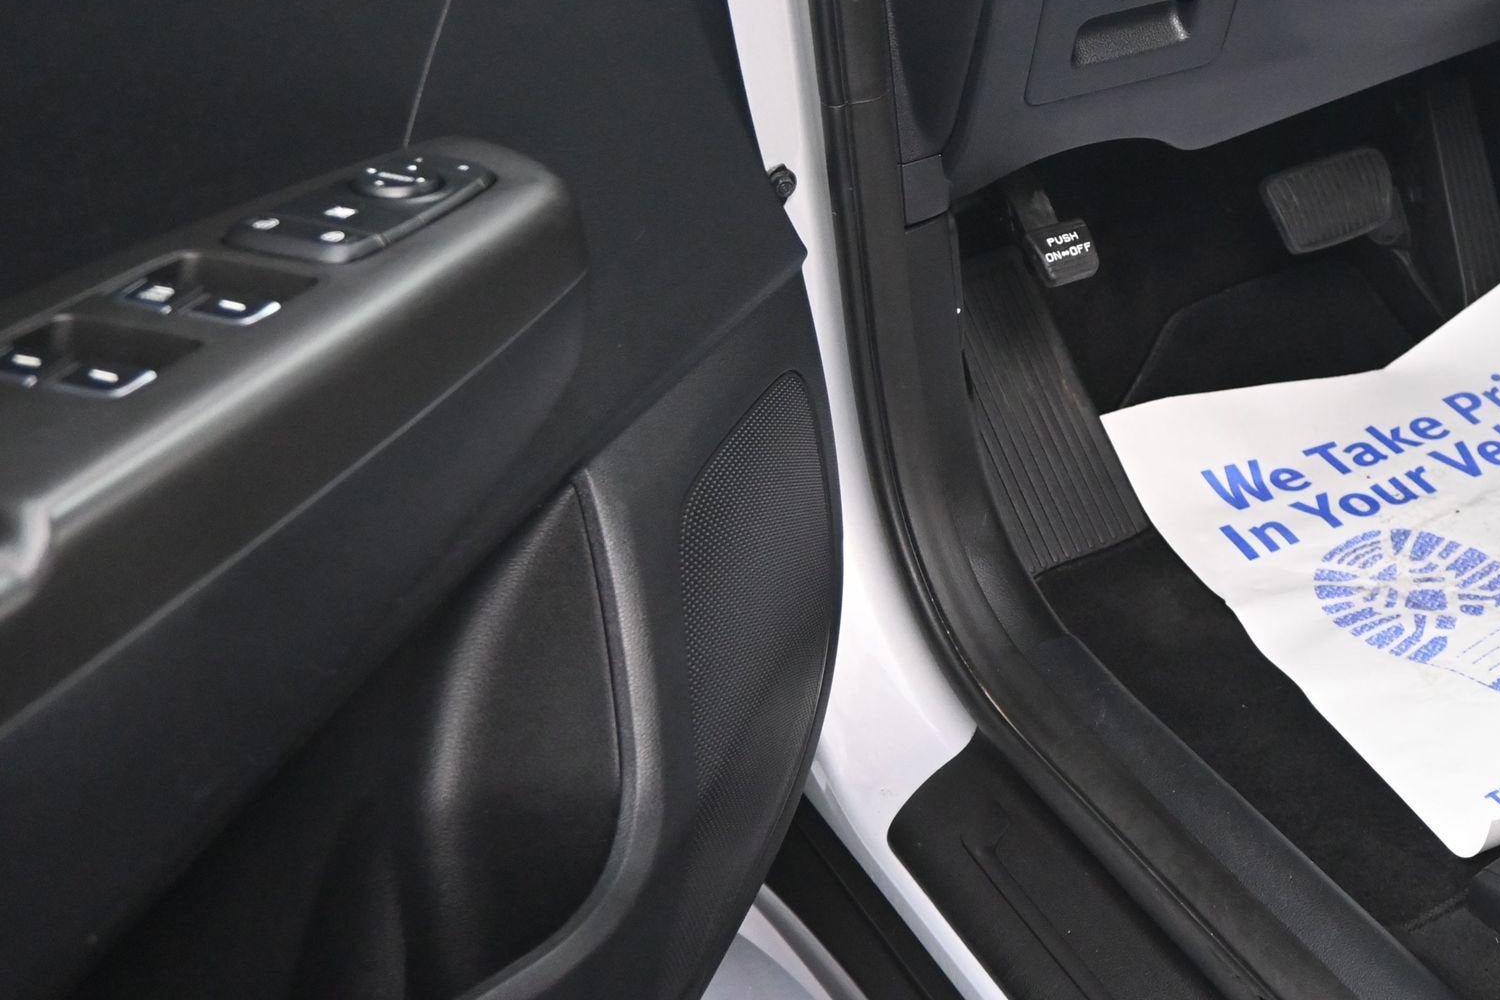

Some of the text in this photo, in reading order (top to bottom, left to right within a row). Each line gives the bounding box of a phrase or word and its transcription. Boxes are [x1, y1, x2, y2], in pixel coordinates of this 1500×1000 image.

[1046, 231, 1079, 247] PUSH
[1200, 459, 1311, 511] We
[1303, 417, 1451, 476] Take
[1220, 520, 1300, 561] In
[1288, 465, 1438, 530] Your
